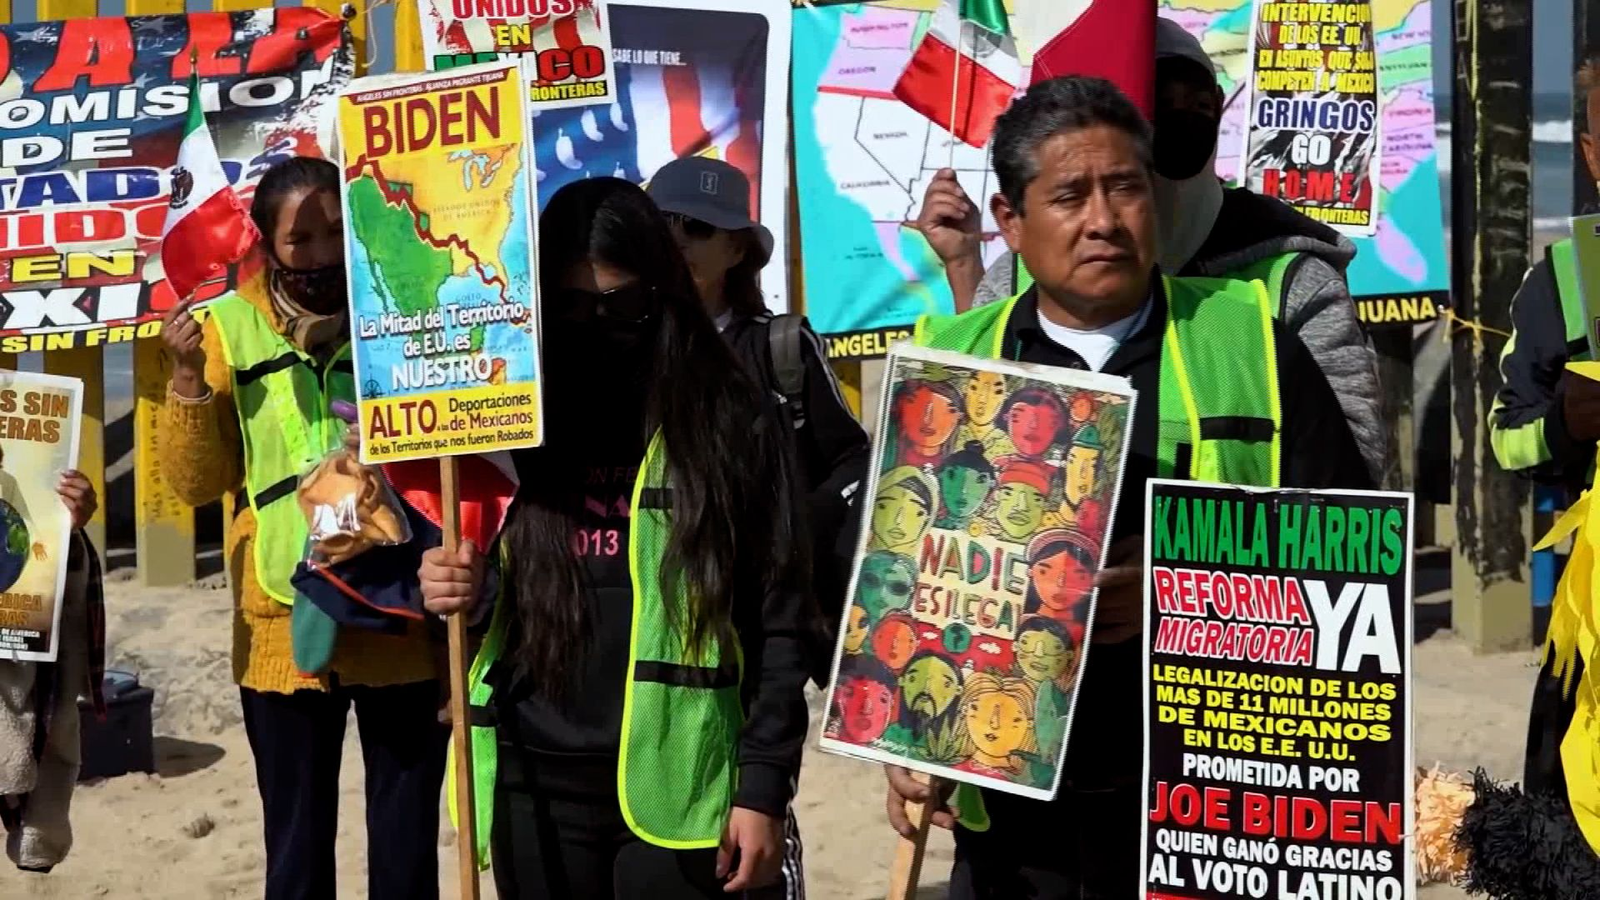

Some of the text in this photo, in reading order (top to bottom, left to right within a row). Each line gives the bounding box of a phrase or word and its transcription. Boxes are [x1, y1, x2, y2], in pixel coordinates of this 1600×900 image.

[496, 24, 531, 46] EN
[1279, 25, 1295, 44] DE
[1296, 25, 1319, 44] LOS
[33, 17, 134, 92] A
[1275, 50, 1323, 68] ASUNTOS
[1328, 51, 1352, 70] QUE
[1258, 70, 1316, 91] COMPETEN
[1320, 72, 1330, 91] A
[364, 86, 500, 158] BIDEN
[1257, 98, 1374, 132] GRINGOS
[3, 128, 133, 166] DE
[1291, 134, 1331, 165] GO
[12, 251, 135, 283] EN
[359, 298, 523, 336] La Mitad del Territorio
[1, 333, 74, 353] SIN
[404, 337, 421, 357] de
[455, 333, 471, 350] es
[391, 353, 492, 391] NUESTRO
[23, 391, 69, 418] SIN
[370, 400, 437, 439] ALTO
[449, 392, 531, 414] Deportaciones
[450, 414, 466, 431] de
[470, 410, 533, 429] Mexicanos
[370, 444, 380, 455] de
[392, 438, 432, 453] Territorios
[434, 438, 448, 453] que
[450, 436, 466, 447] nos
[468, 433, 495, 446] fueron
[497, 429, 533, 443] Robados
[1154, 496, 1402, 575] KAMALA HARRIS
[920, 533, 1028, 596] NADIE
[1153, 566, 1313, 626] REFORMA
[1154, 616, 1314, 667] MIGRATORIA
[1303, 579, 1401, 674] YA
[1153, 663, 1396, 701] LEGALIZACION DE LOS
[1156, 685, 1391, 721] MAS DE 11 MILLONES
[1158, 705, 1391, 742] DE MEXICANOS
[1183, 729, 1356, 762] EN LOS E.E. U.U.
[1182, 752, 1360, 793] PROMETIDA POR
[1149, 780, 1402, 845] JOE BIDEN
[1156, 828, 1392, 872] QUIEN GANÓ GRACIAS
[1148, 853, 1402, 900] AL VOTO LATINO
